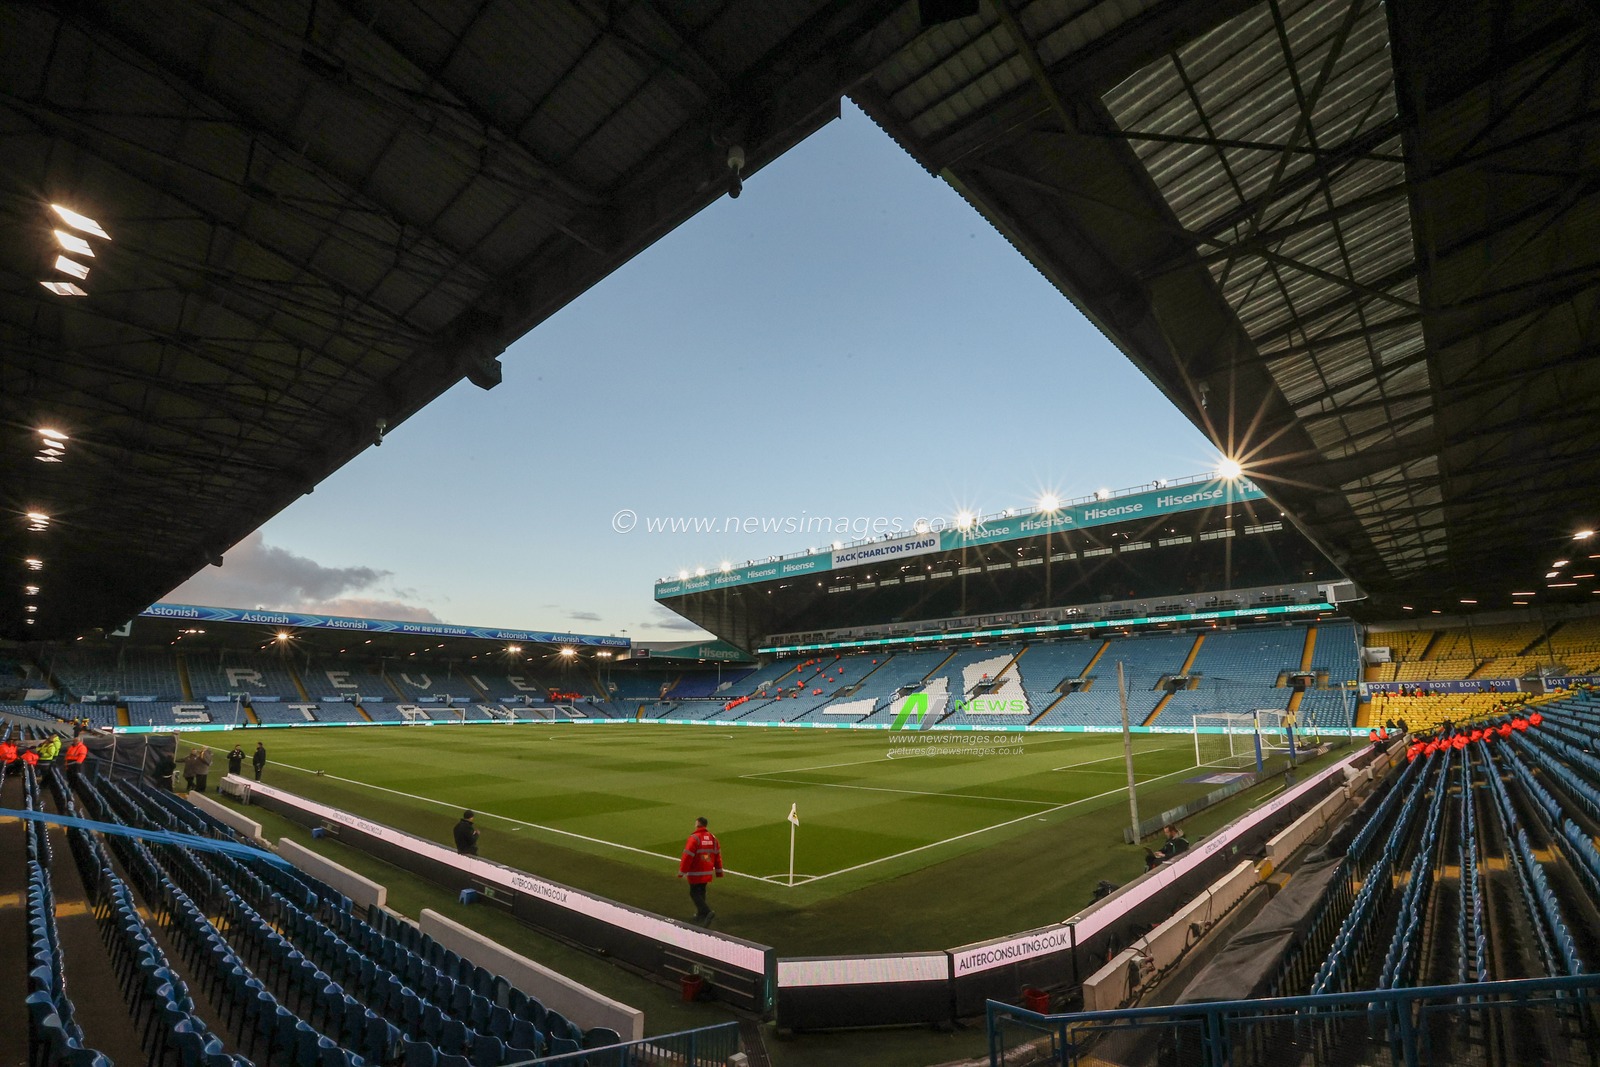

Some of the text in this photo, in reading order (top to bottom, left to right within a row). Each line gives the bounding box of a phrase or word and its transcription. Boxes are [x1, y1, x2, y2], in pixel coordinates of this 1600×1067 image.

[1156, 489, 1223, 508] Hisense
[1084, 502, 1143, 520] Hisense
[1020, 515, 1072, 531] Hisense
[962, 526, 1010, 541] Hisense
[836, 538, 936, 563] JACK CHARLTON STAND
[783, 560, 815, 573] Hisense
[714, 573, 742, 585] Hisense
[747, 567, 777, 579] Hisense
[657, 585, 681, 595] Hisense
[685, 579, 710, 590] Hisense
[143, 605, 199, 618] Astonish
[241, 612, 290, 624] Astonish
[326, 618, 368, 630] Astonish
[403, 624, 467, 635] DON REVIE STAND
[497, 631, 528, 640] Astonish
[551, 634, 580, 643] Astonish
[601, 638, 627, 646] Astonish
[699, 647, 740, 659] Hisense
[225, 668, 537, 692] REVIE
[1547, 678, 1566, 686] BOXT
[171, 704, 588, 723] STAND
[1306, 727, 1367, 736] Hisense
[959, 933, 1067, 970] ALITERCONSULTING.CO.UK
